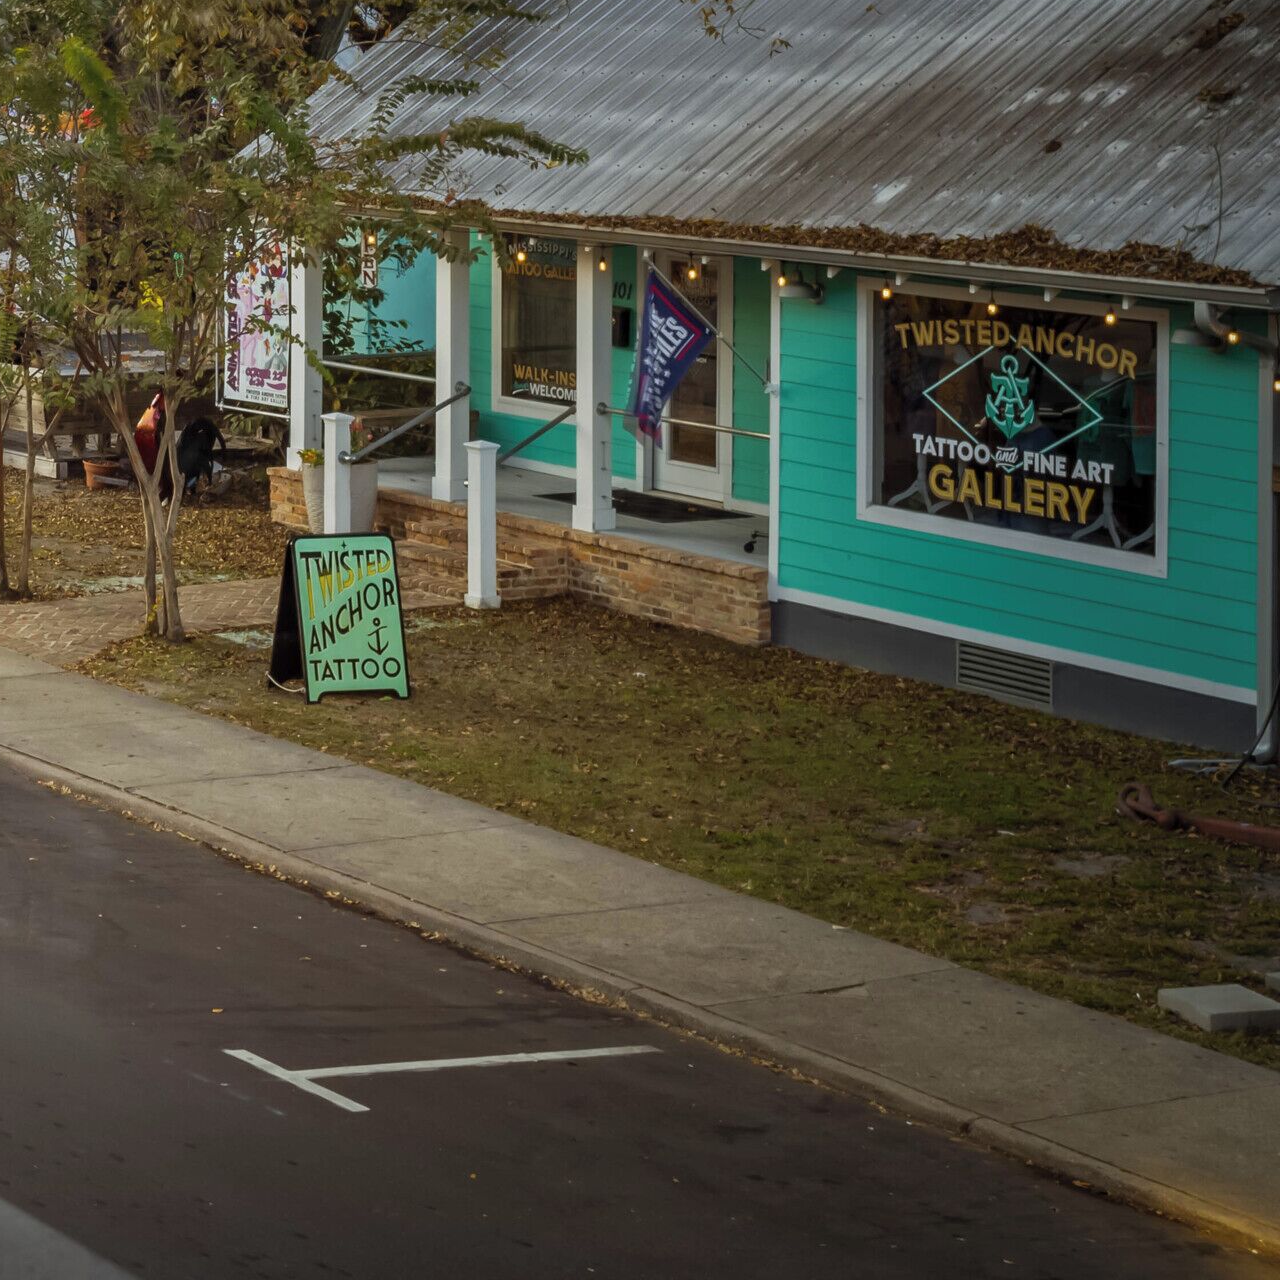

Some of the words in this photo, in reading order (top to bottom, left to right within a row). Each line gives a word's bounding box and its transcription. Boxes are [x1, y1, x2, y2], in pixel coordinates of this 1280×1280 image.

[543, 264, 577, 280] GALLE
[613, 282, 632, 301] 101
[226, 304, 240, 392] ANIMTIO
[514, 363, 576, 388] WALK-INS
[894, 320, 1010, 349] TWISTED
[1015, 325, 1138, 380] ANCHOR
[912, 433, 990, 464] TATTOO
[994, 446, 1019, 467] and
[1023, 451, 1067, 477] FINE
[1071, 459, 1114, 484] ART
[928, 464, 1095, 524] GALLERY
[299, 549, 391, 620] TWISTED
[309, 577, 396, 654] ANCHOR
[309, 657, 401, 682] TATTOO
